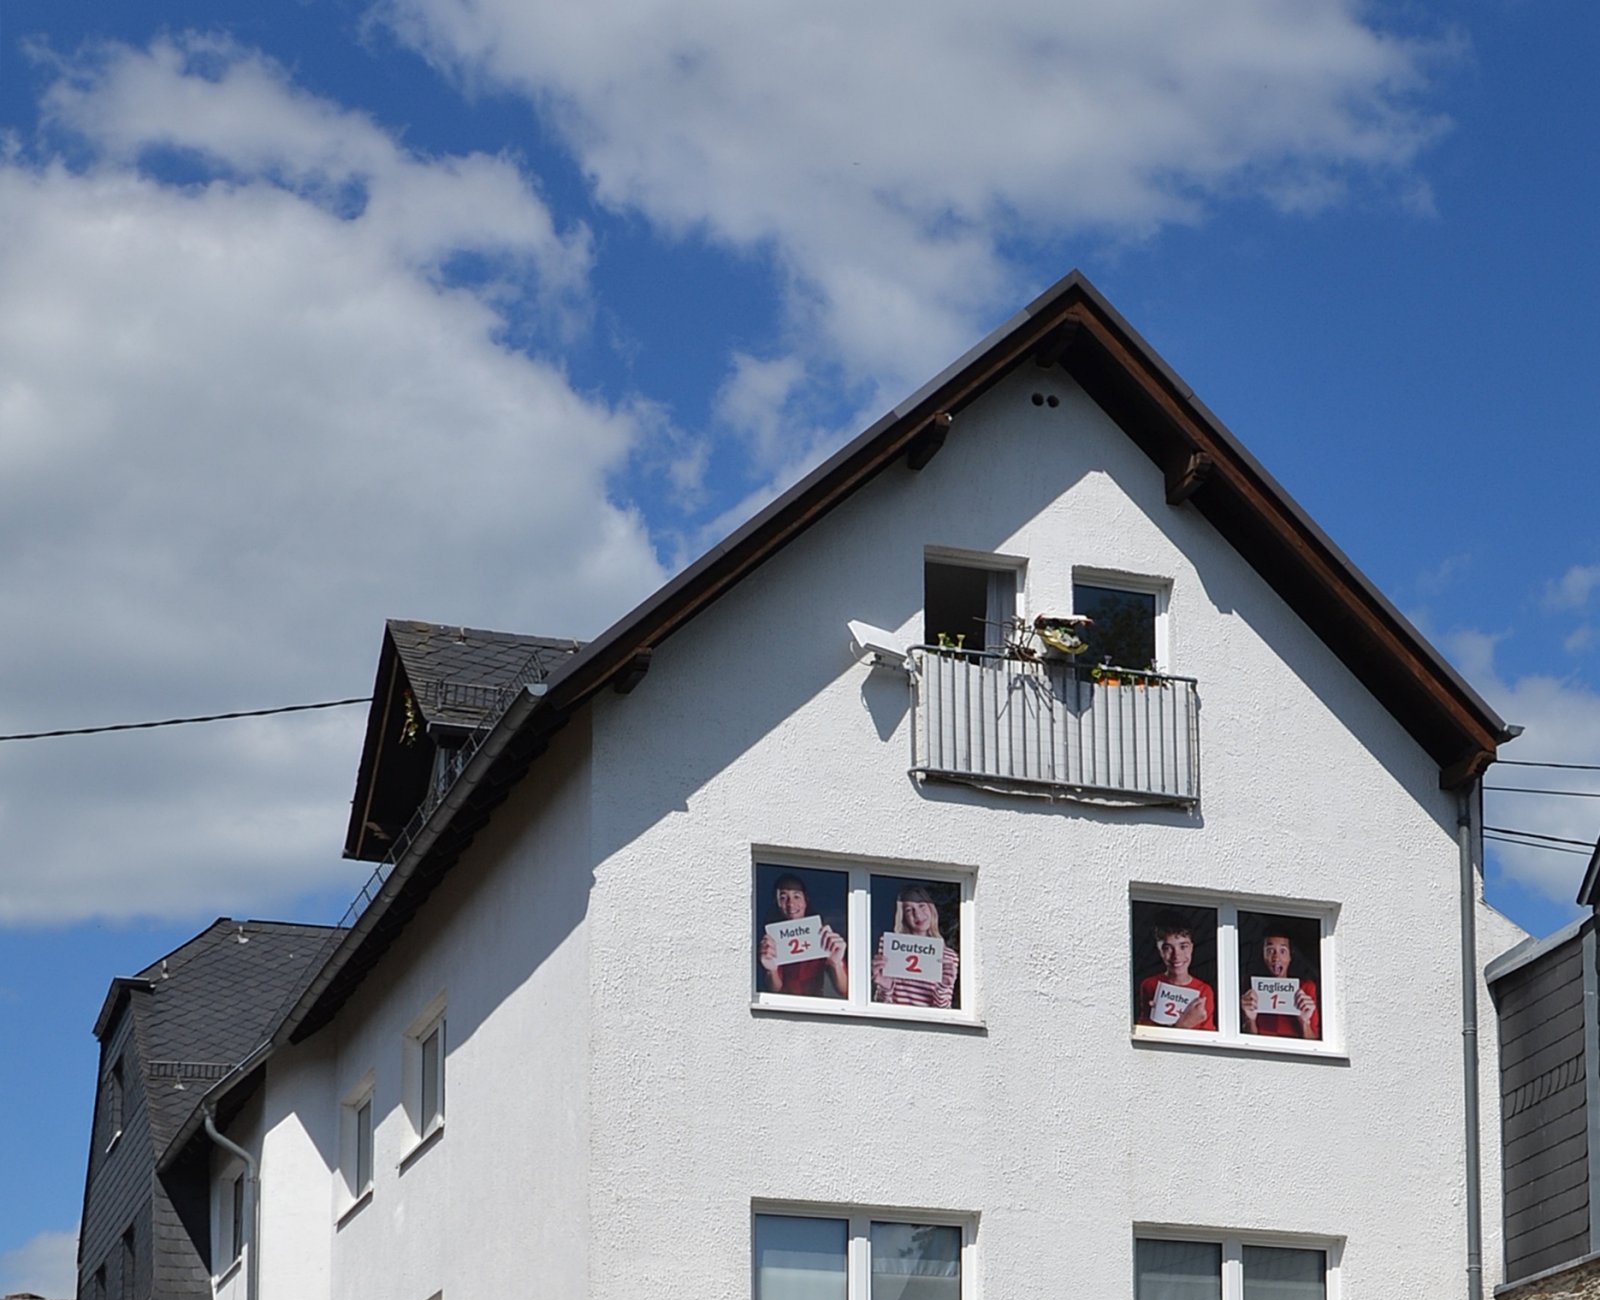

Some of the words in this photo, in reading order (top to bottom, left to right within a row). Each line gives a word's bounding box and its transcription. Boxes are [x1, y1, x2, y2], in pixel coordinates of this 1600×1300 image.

[779, 926, 811, 939] Mathe
[788, 938, 811, 954] 2+
[891, 939, 936, 955] Deutsch
[905, 955, 922, 973] 2
[1257, 981, 1295, 994] Englisch
[1160, 989, 1189, 1004] Mathe
